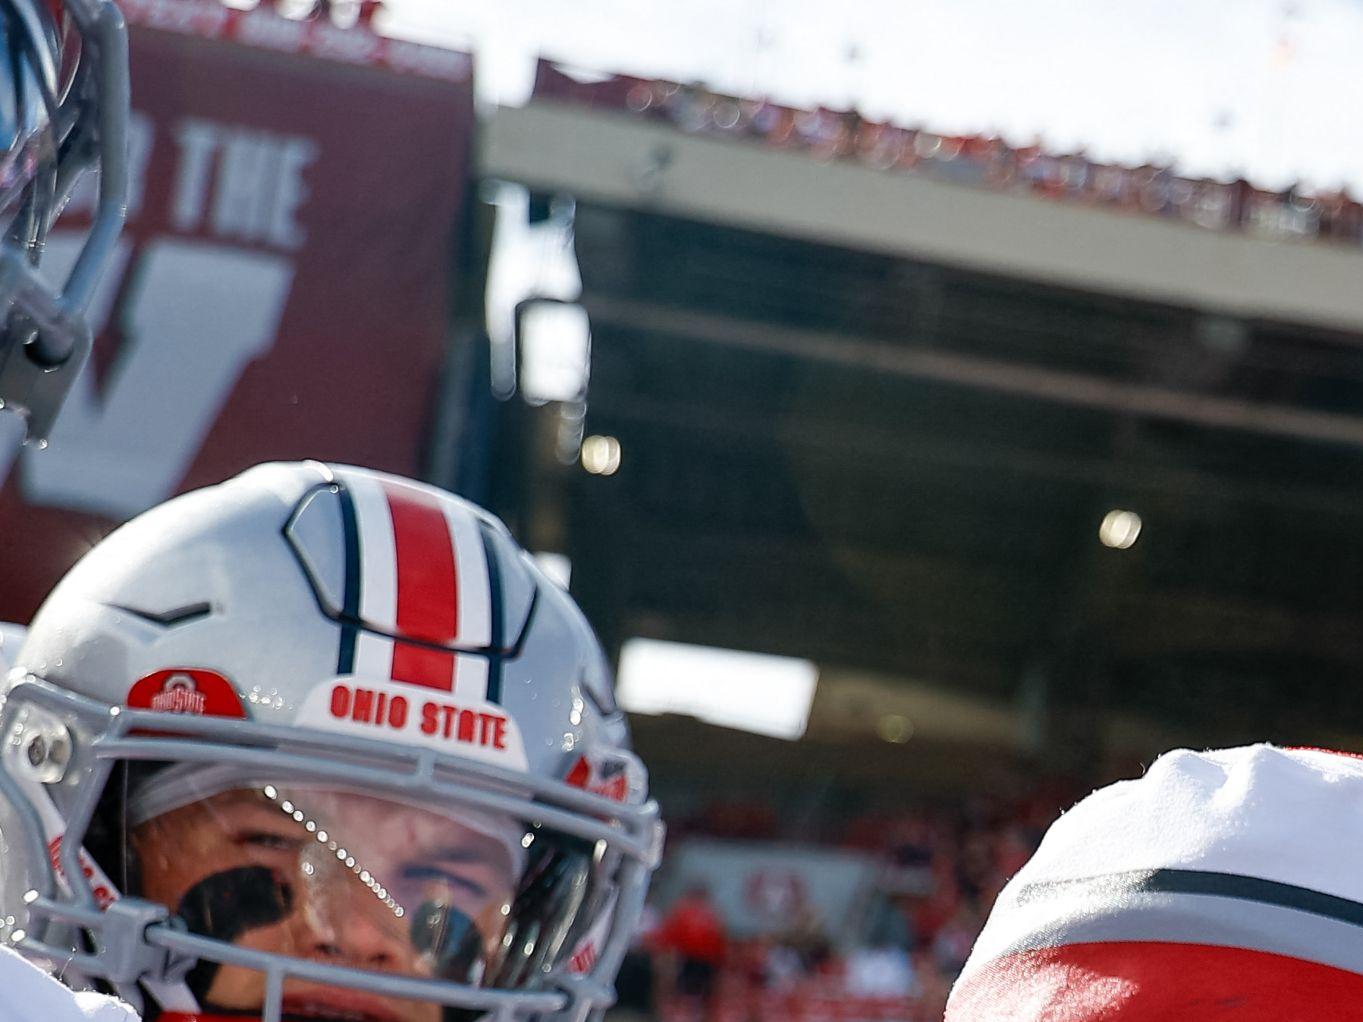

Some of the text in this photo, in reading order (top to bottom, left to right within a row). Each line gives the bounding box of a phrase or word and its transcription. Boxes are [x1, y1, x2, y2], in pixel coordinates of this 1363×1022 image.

[172, 118, 319, 245] THE
[330, 685, 507, 749] OHIO STATE
